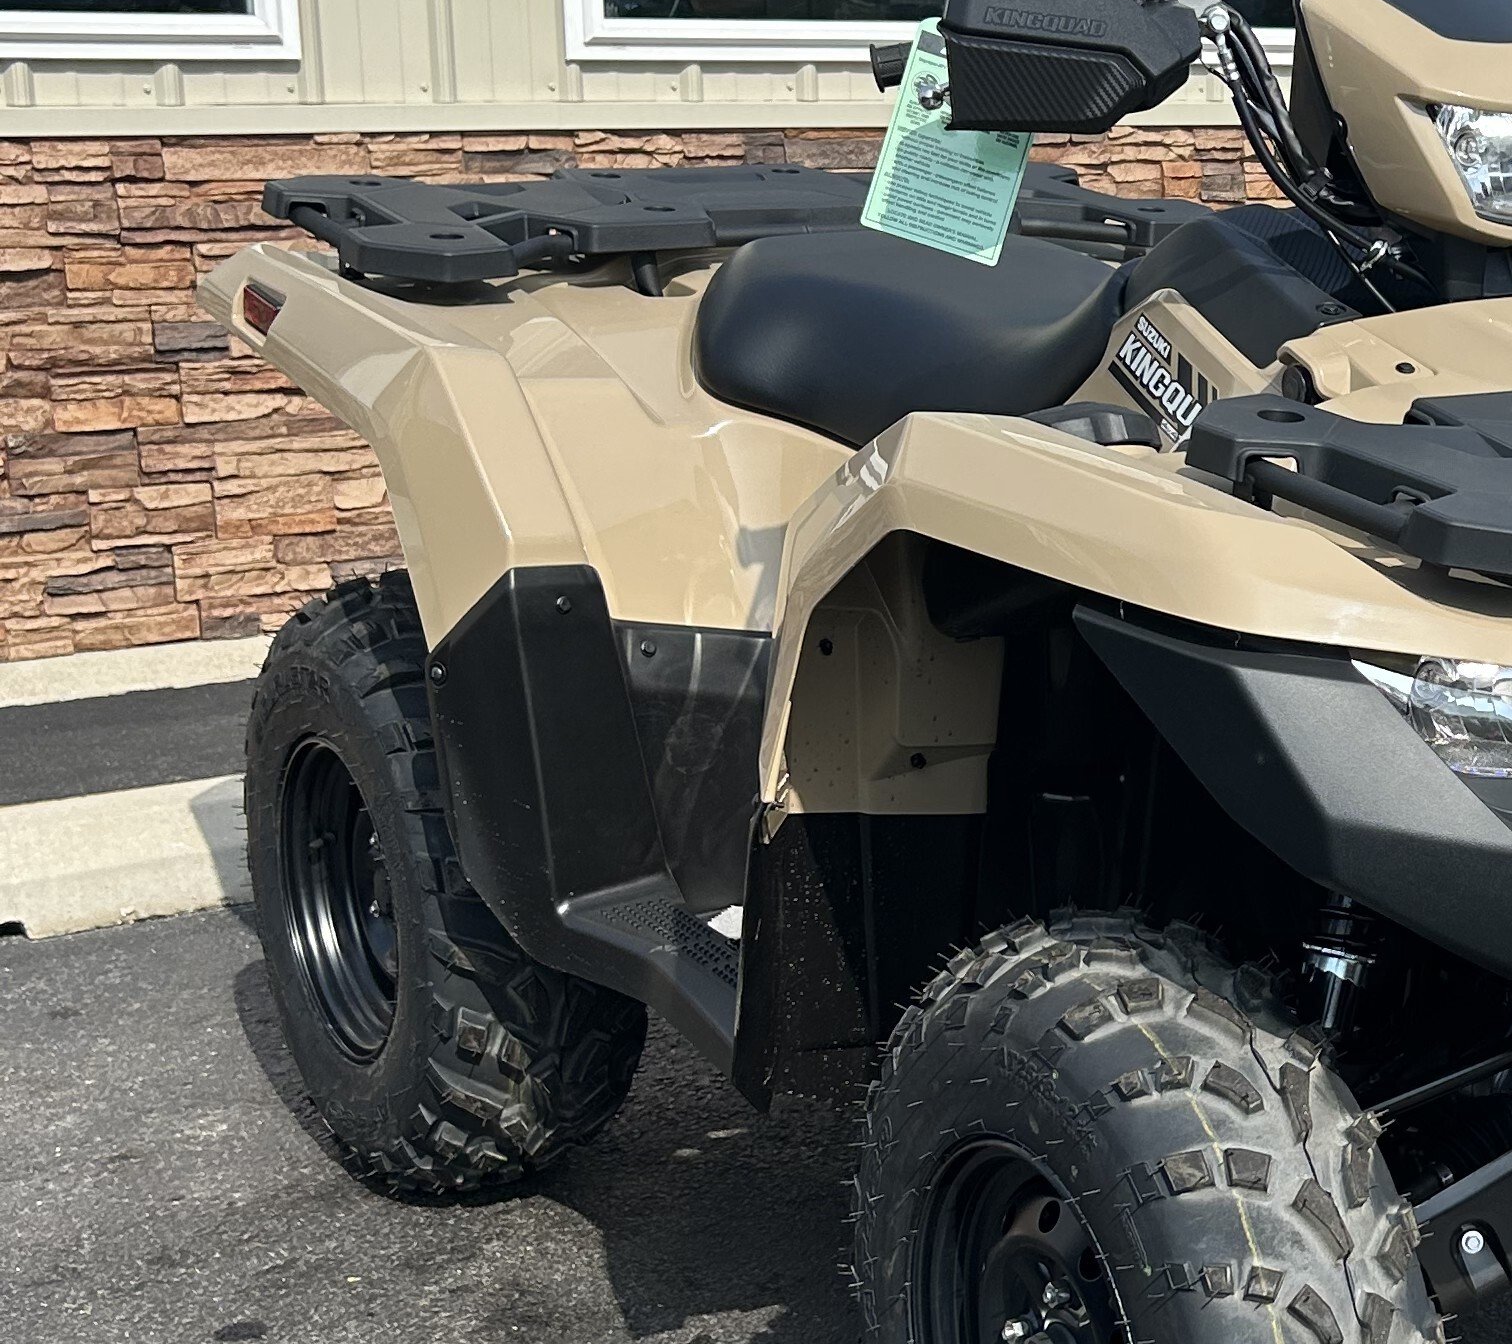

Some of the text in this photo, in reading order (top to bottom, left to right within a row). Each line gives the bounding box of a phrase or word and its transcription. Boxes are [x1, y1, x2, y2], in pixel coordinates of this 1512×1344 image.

[984, 6, 1108, 38] KINGQUAD
[1136, 315, 1172, 360] SUZUKI
[1118, 332, 1203, 428] KINGQU
